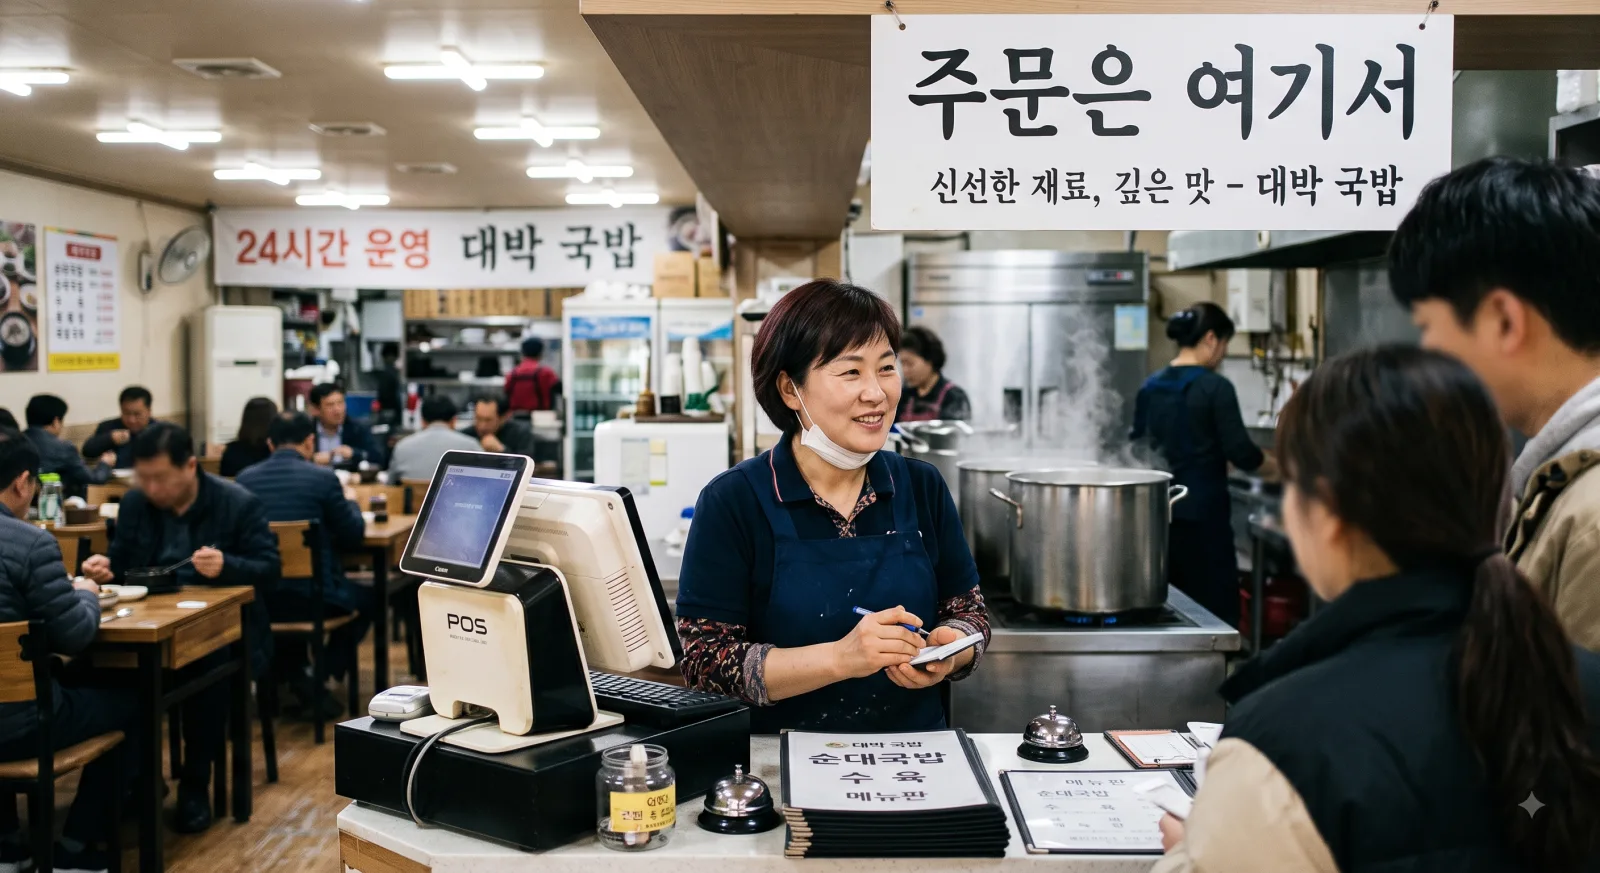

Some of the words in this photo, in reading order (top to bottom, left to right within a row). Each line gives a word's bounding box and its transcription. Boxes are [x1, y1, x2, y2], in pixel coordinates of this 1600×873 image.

[908, 44, 1152, 141] 주문은
[1186, 43, 1416, 141] 여기서
[930, 167, 1020, 205] 신선한
[1031, 167, 1101, 208] 재료,
[1114, 167, 1174, 205] 깊은
[1185, 167, 1215, 206] 맛
[1256, 165, 1323, 207] 대박
[1335, 164, 1404, 206] 국밥
[237, 228, 349, 269] 24시간
[364, 228, 430, 269] 운영
[462, 223, 542, 271] 대박
[559, 222, 643, 270] 국밥
[447, 612, 488, 635] POS
[808, 752, 947, 766] 순대국밥
[846, 791, 928, 802] 메뉴판
